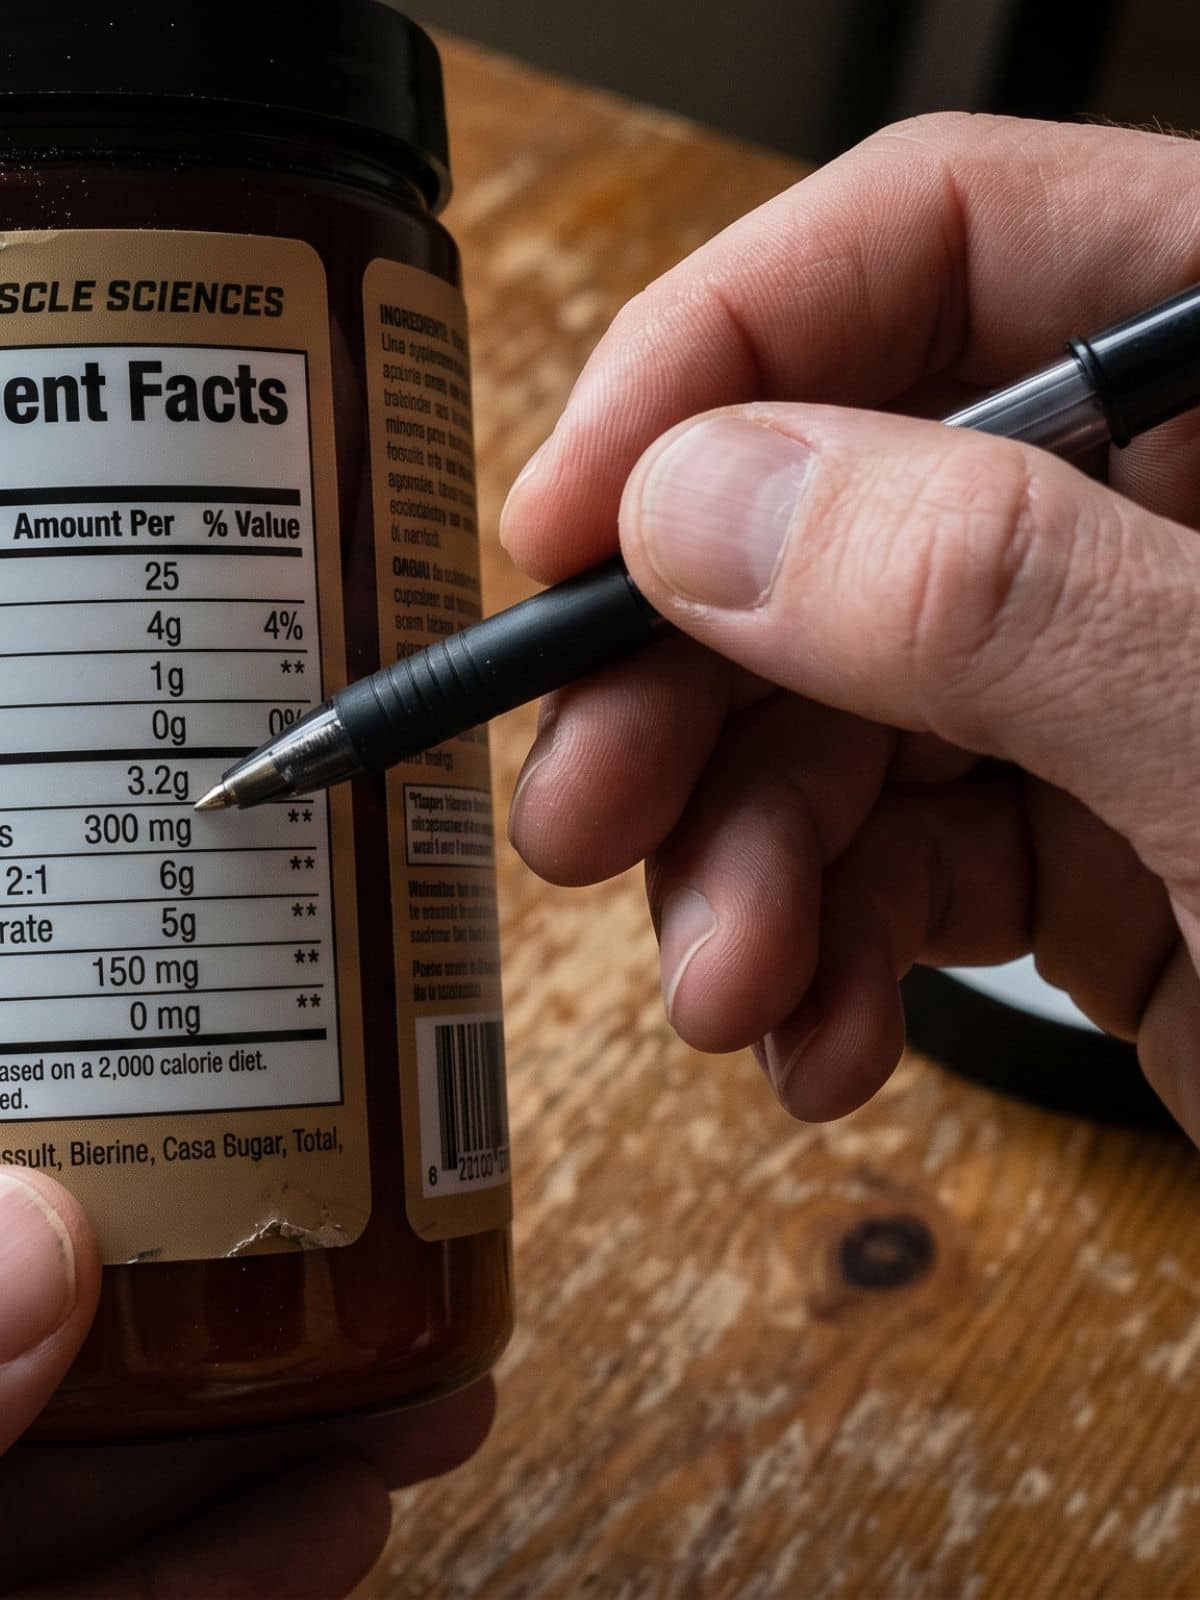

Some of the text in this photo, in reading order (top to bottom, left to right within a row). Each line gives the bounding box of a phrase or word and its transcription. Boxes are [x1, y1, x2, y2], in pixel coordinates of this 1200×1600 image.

[105, 279, 285, 317] SCIENCES
[129, 360, 288, 425] Facts
[13, 510, 301, 540] Amount Per % Value
[144, 561, 180, 592] 25
[147, 612, 182, 646] 4g
[263, 610, 303, 640] 4%
[150, 662, 185, 697] 1g
[152, 710, 187, 745] 0g
[127, 766, 189, 802] 3.2g
[84, 814, 139, 846] 300
[148, 817, 192, 849] mg
[6, 865, 49, 898] 2:1
[159, 861, 195, 895] 6g
[161, 908, 197, 942] 5g
[93, 956, 146, 988] 150
[155, 961, 200, 991] mg
[130, 1002, 147, 1031] 0
[157, 1006, 201, 1038] mg
[51, 1061, 75, 1080] on
[81, 1062, 93, 1079] a
[99, 1054, 154, 1080] 2,000
[160, 1052, 223, 1075] calorie
[229, 1050, 268, 1072] diet.
[71, 1138, 156, 1167] Bierine,
[163, 1136, 217, 1161] Casa
[292, 1126, 343, 1154] Total,
